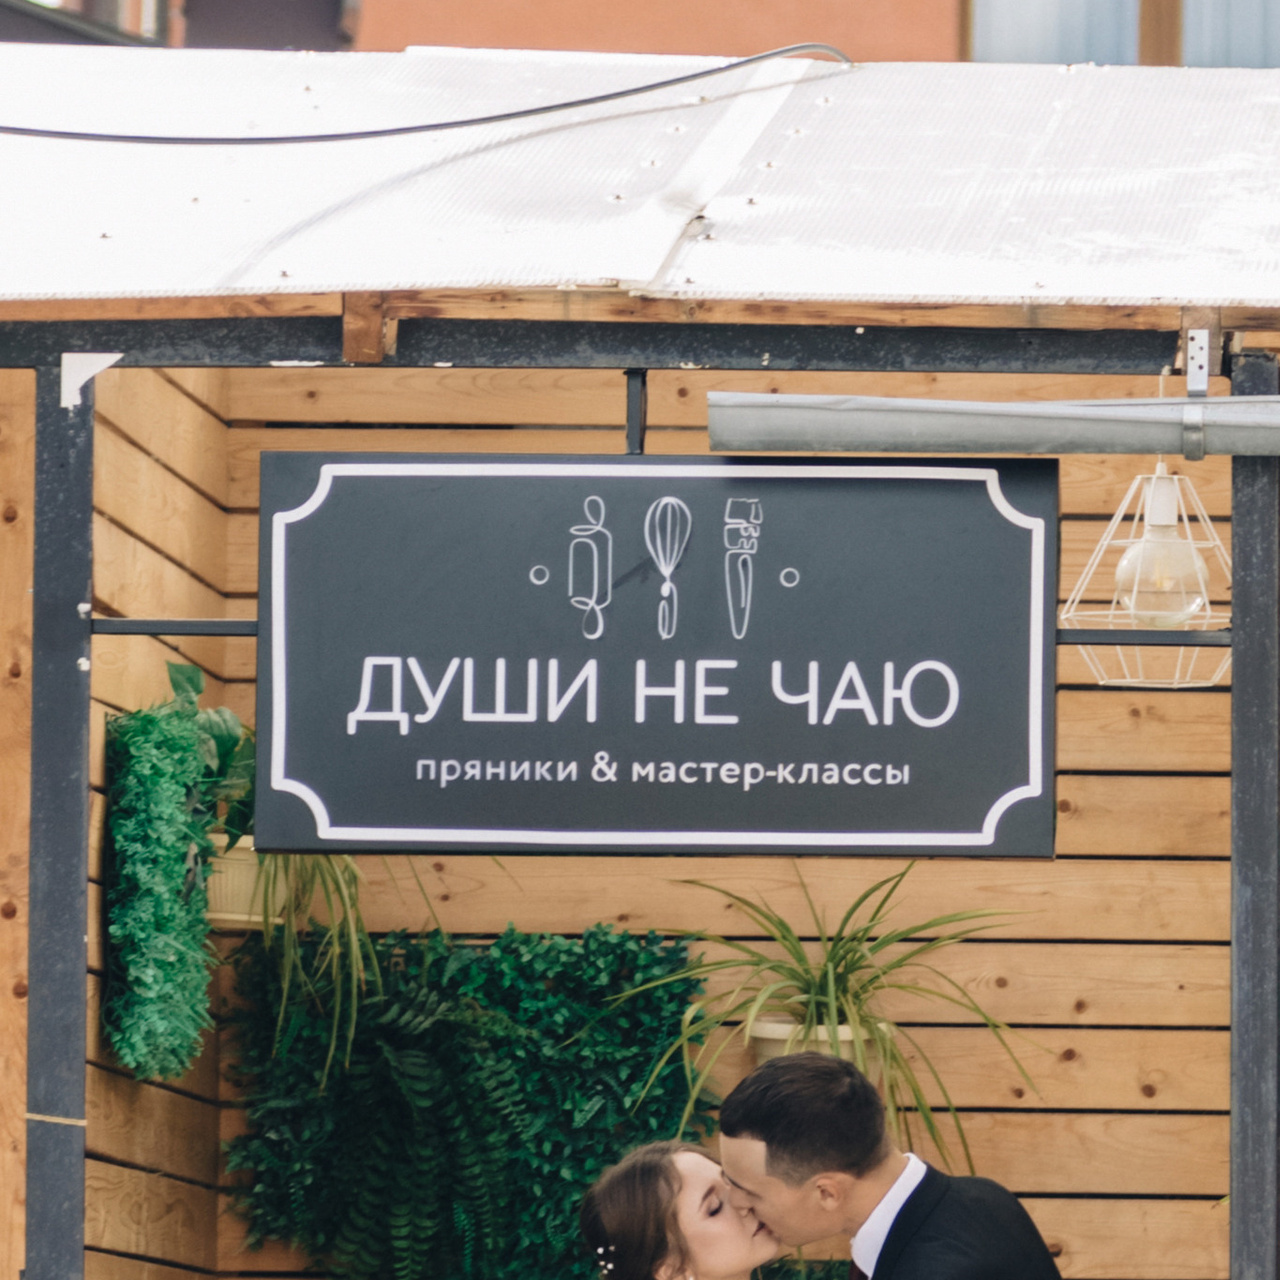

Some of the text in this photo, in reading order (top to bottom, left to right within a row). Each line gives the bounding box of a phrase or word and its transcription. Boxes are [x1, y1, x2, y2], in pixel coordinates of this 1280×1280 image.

[346, 655, 960, 735] ДУШИ НЕ ЧАЮ
[416, 750, 910, 792] пряники & мастер-классы
